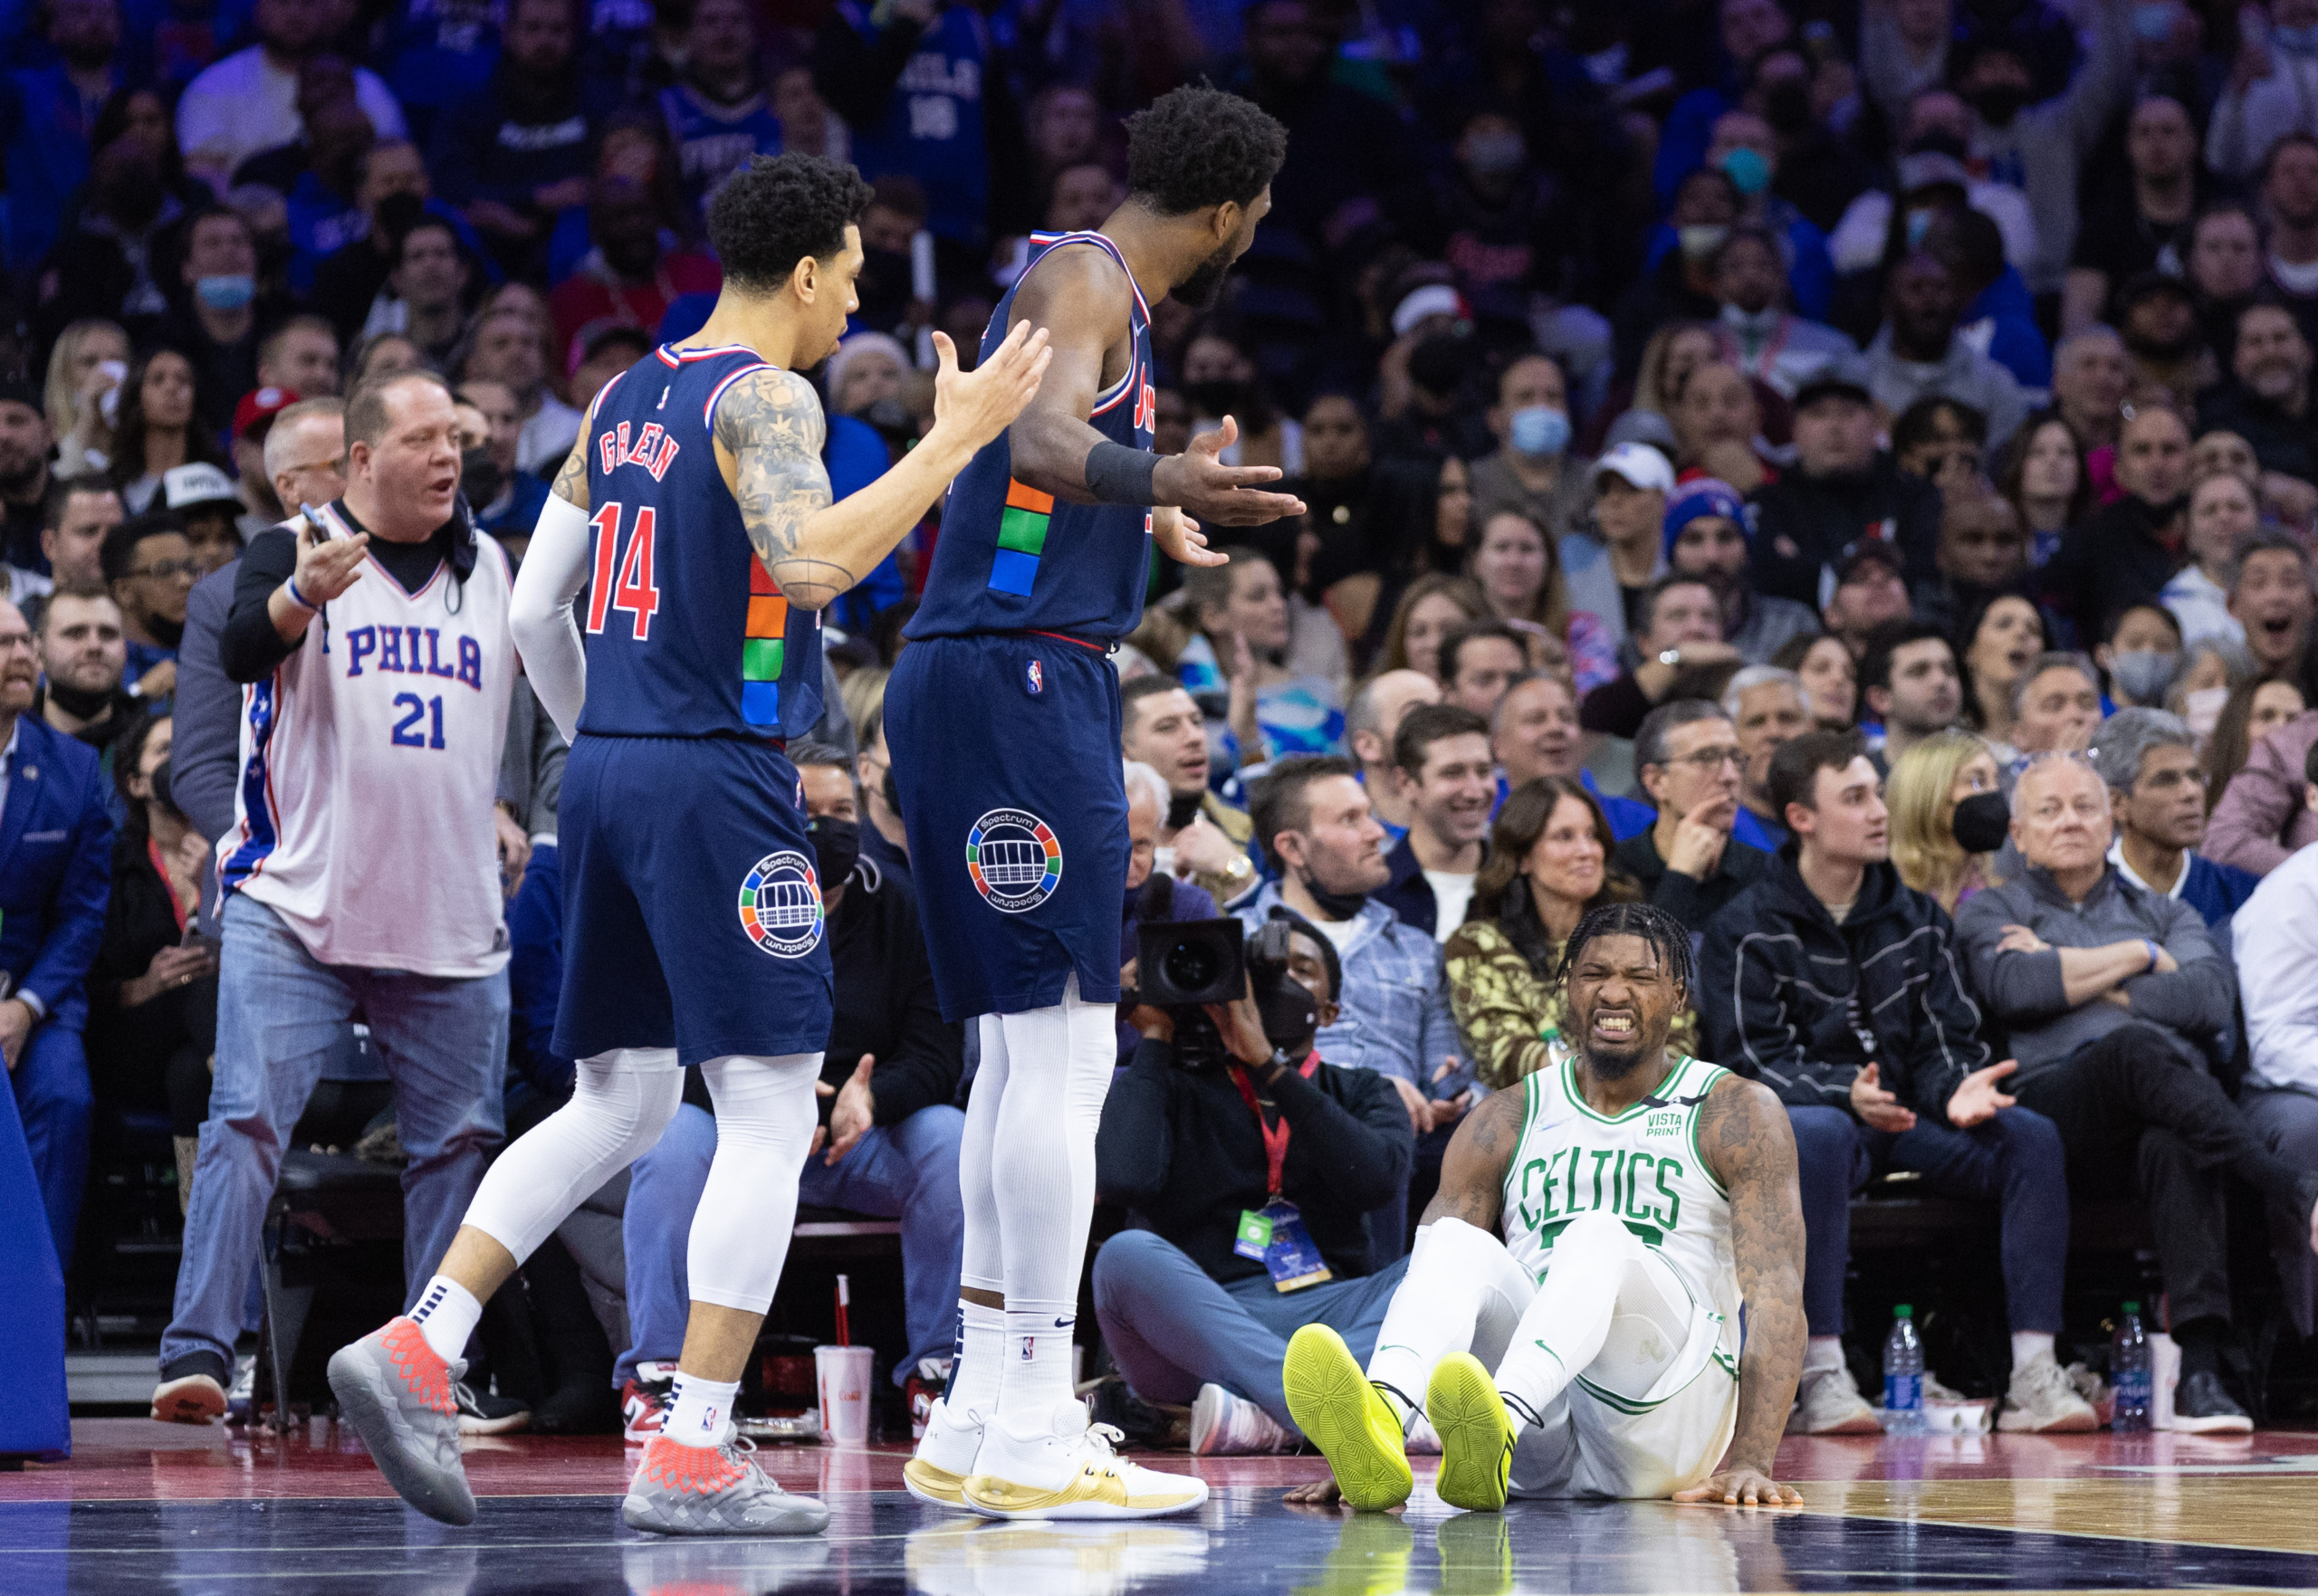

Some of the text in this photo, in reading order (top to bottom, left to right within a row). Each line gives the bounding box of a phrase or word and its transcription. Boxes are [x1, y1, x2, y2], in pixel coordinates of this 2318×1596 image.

[599, 420, 679, 482] GREEN
[585, 502, 660, 640] 14
[346, 625, 481, 693] PHILA
[391, 691, 445, 750] 21
[981, 814, 1033, 829] Spectrum
[761, 855, 806, 872] Spectrum
[991, 893, 1042, 908] Spectrum
[765, 936, 814, 953] Spectrum
[1648, 1113, 1681, 1127] VISTA
[1646, 1127, 1681, 1137] PRINT
[1518, 1146, 1683, 1232] CELTICS
